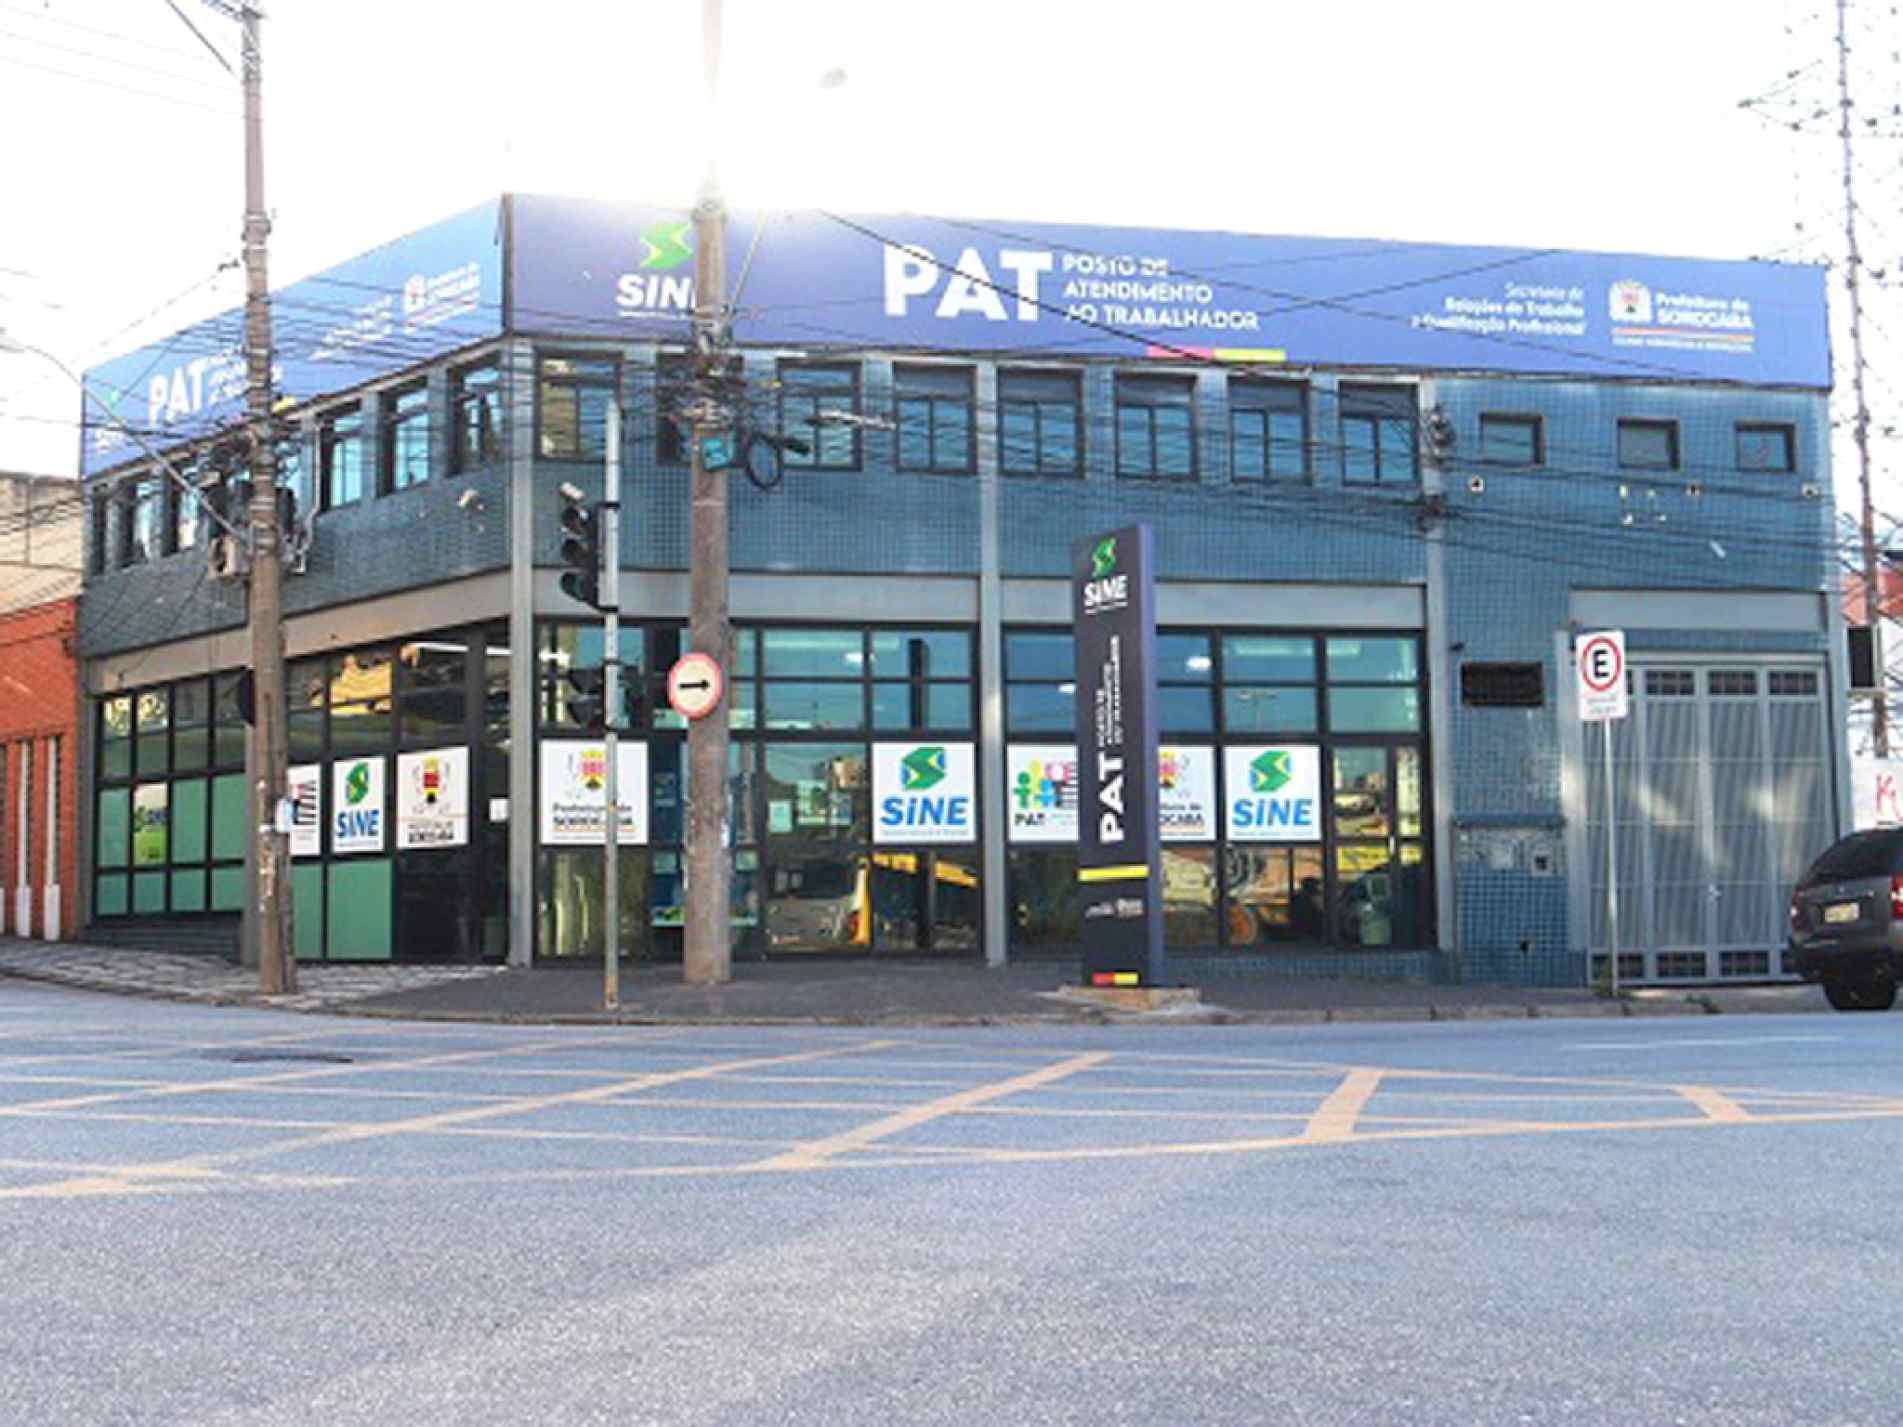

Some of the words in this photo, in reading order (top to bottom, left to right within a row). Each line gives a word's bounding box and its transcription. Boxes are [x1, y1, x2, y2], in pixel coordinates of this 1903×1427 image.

[1062, 253, 1136, 277] POSTO
[1140, 258, 1168, 277] DE
[616, 274, 696, 309] SIN
[884, 243, 1053, 322] PAT
[1064, 279, 1213, 304] ATENDIMENTO
[1066, 304, 1098, 323] AO
[1104, 304, 1262, 331] TRABALHADOR
[149, 355, 207, 426] PAT
[1084, 575, 1128, 606] SINE
[1593, 650, 1609, 678] E
[1098, 752, 1124, 843] PAT
